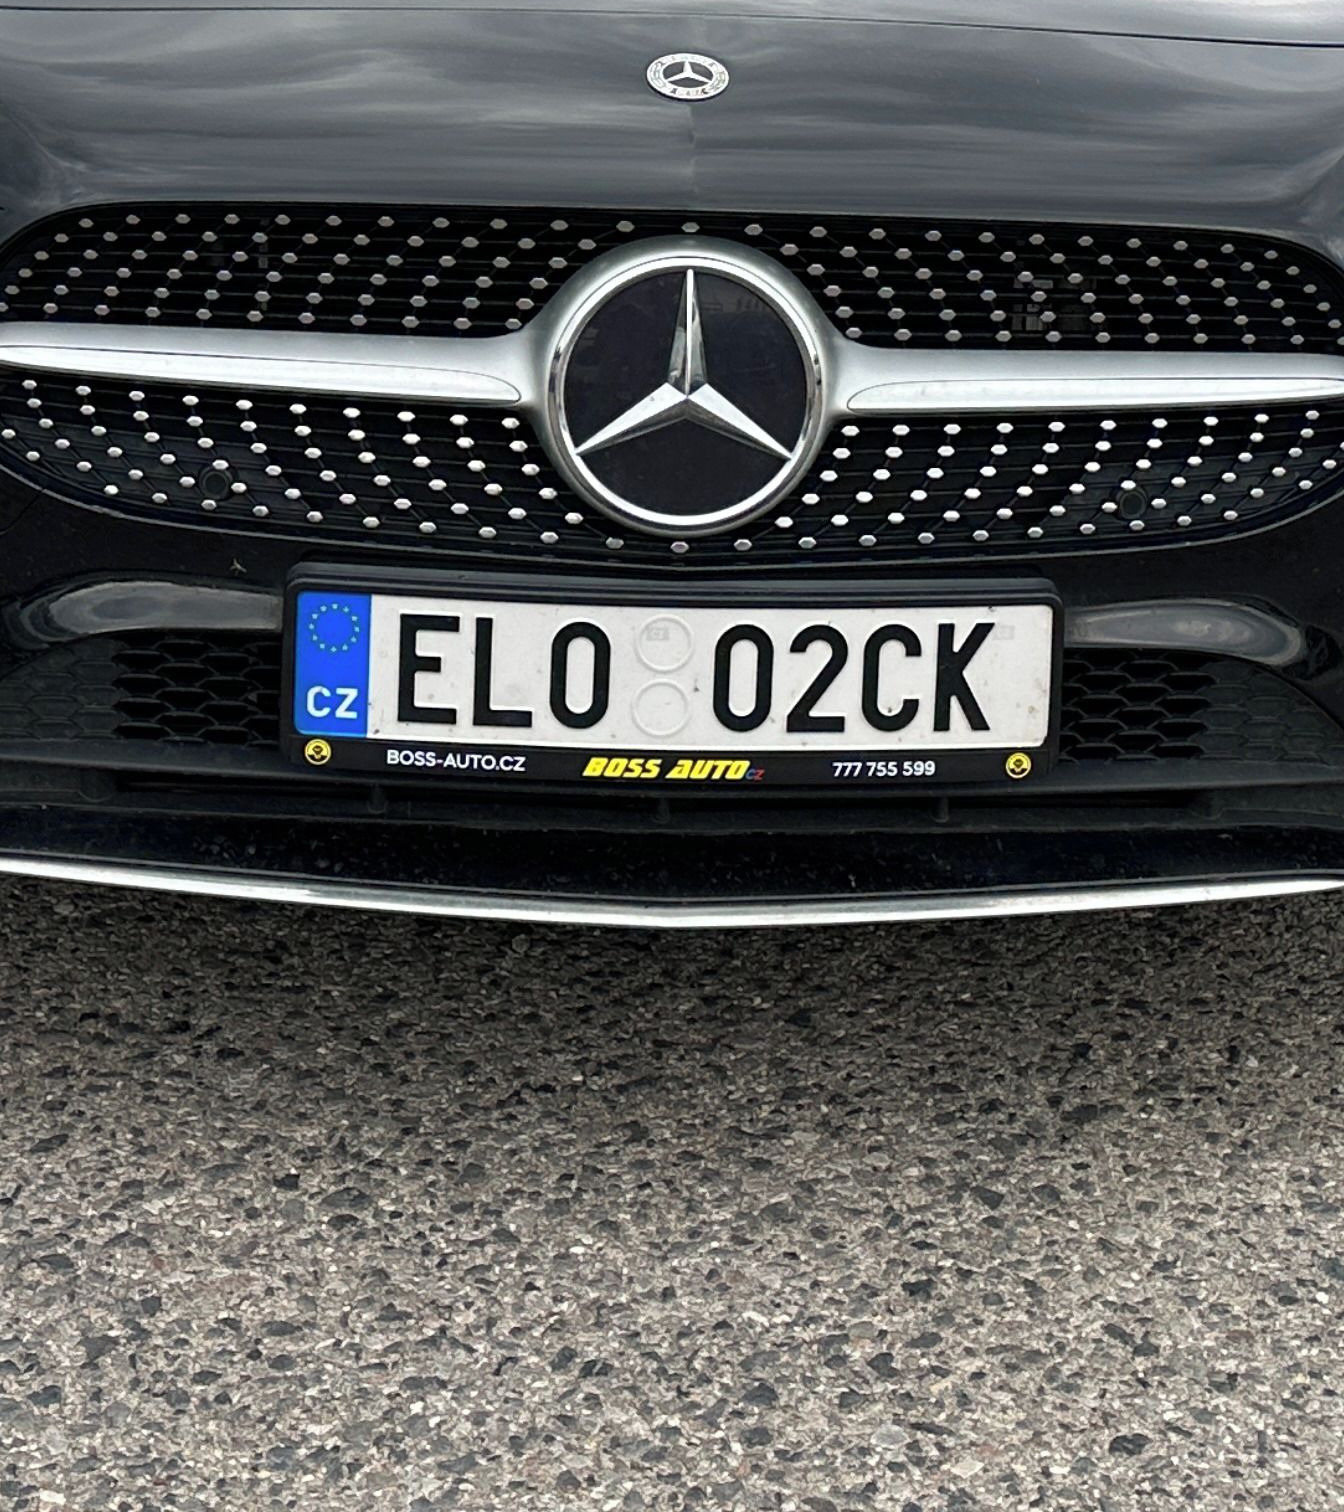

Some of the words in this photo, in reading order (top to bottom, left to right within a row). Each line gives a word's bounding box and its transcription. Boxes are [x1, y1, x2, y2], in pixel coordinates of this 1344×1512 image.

[306, 685, 358, 719] CZ
[386, 749, 526, 772] BOSS-AUTO.CZ
[582, 757, 662, 779] BOSS
[665, 759, 750, 780] AUTO
[832, 761, 863, 777] 777
[866, 761, 898, 777] 755
[902, 760, 936, 777] 599
